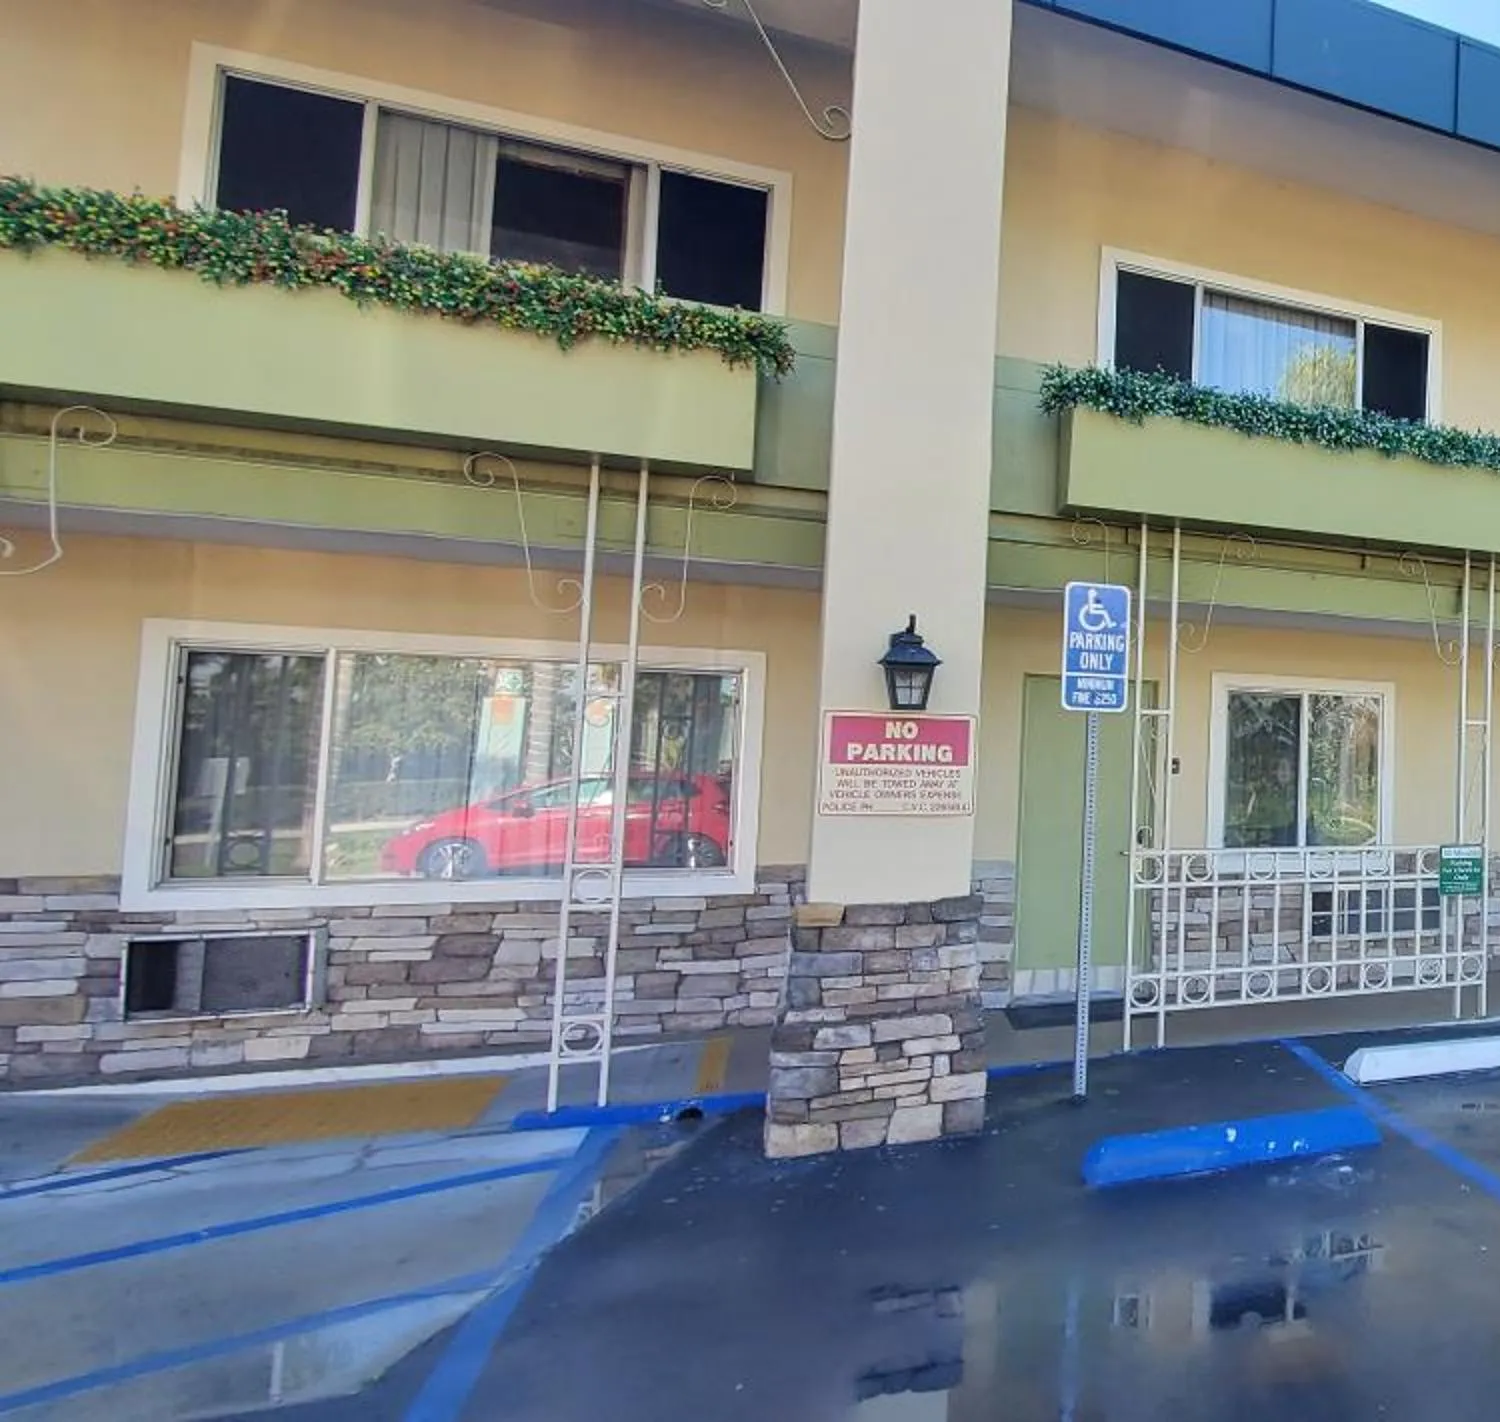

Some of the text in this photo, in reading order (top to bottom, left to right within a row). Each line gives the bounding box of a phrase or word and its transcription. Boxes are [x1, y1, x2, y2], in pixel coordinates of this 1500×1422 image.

[1069, 631, 1125, 653] PARKING
[1080, 652, 1113, 671] ONLY
[1077, 677, 1115, 691] MINIMUM
[1072, 691, 1091, 704] FINE
[885, 721, 919, 739] NO
[847, 743, 953, 763] PARKING
[834, 767, 961, 779] UNAUTHORIZED VEHICLES
[837, 779, 960, 789] WILL BE TOWED AWAY AT
[829, 789, 868, 799] VEHICLE
[822, 802, 856, 812] POLICE
